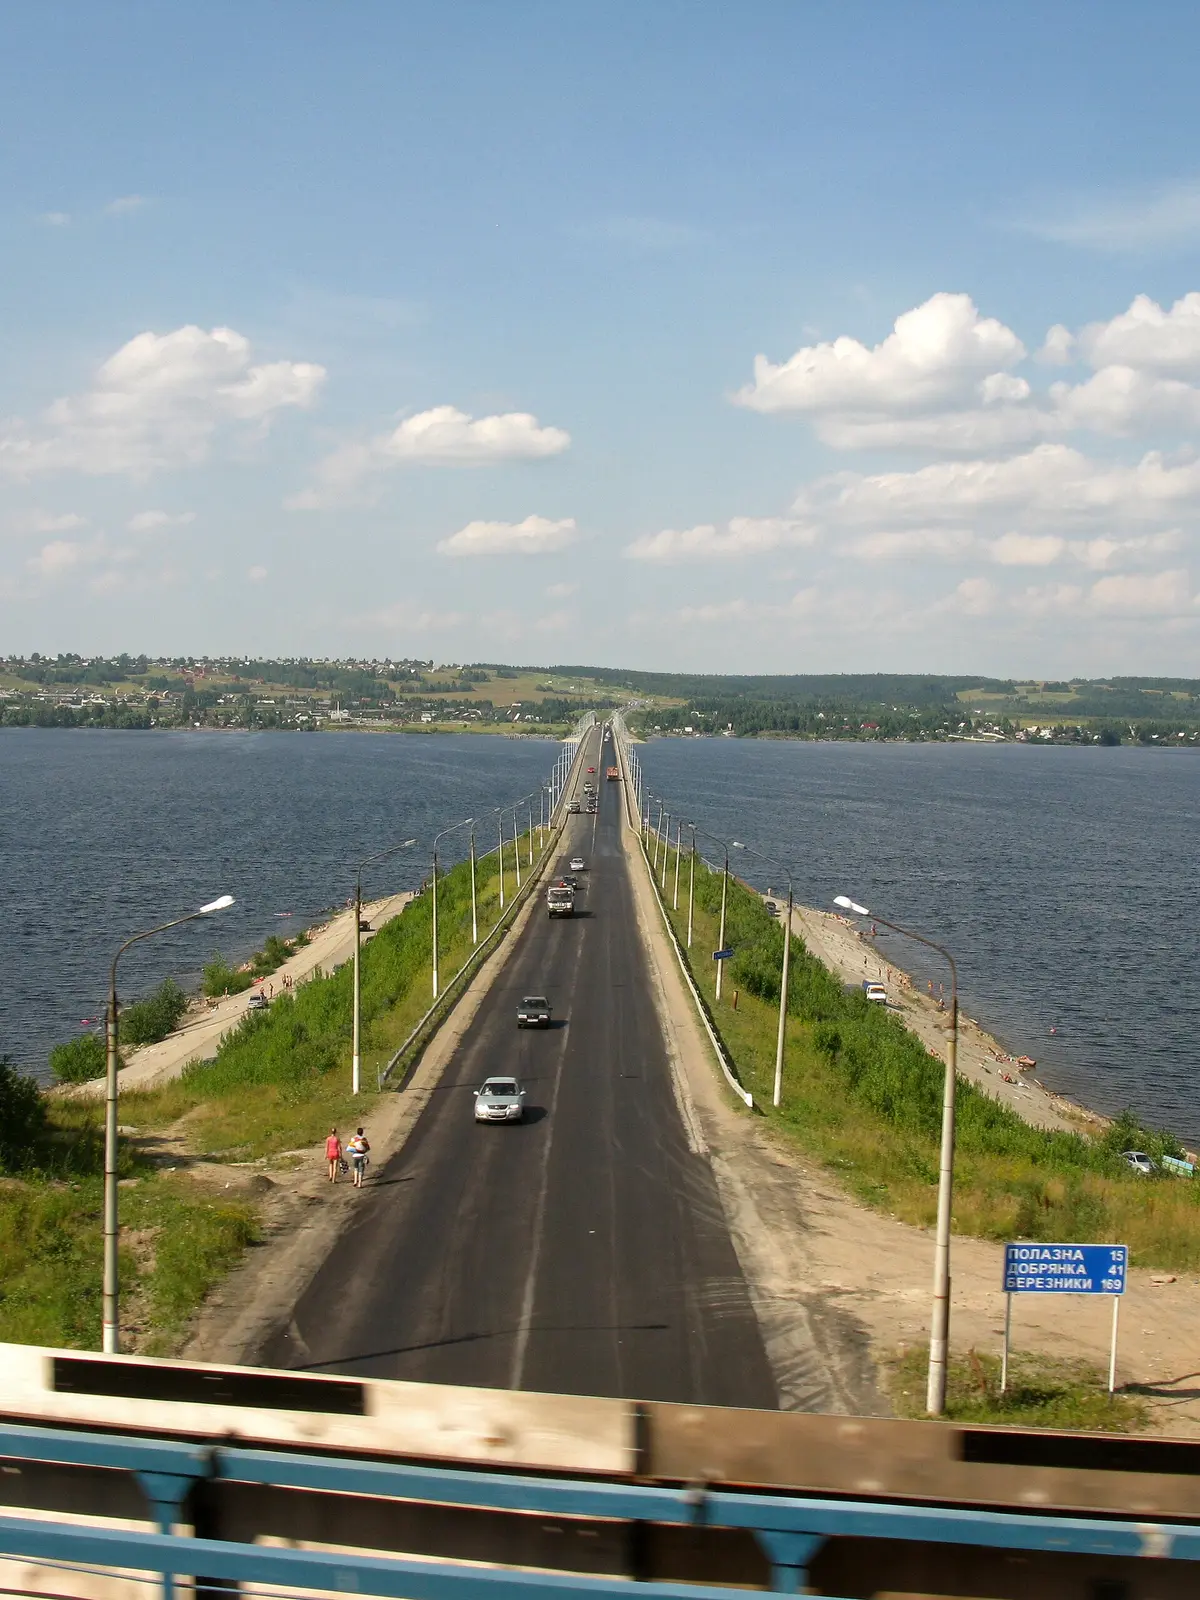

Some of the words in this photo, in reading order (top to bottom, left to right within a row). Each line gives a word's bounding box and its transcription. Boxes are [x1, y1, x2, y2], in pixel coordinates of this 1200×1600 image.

[1008, 1248, 1084, 1261] ПОЛАЗНА
[1109, 1250, 1124, 1261] 15
[1007, 1263, 1087, 1275] ДОБРЯНКА
[1108, 1264, 1124, 1276] 41
[1007, 1277, 1092, 1289] БЕРЕЗНИКИ
[1101, 1279, 1122, 1290] 169
